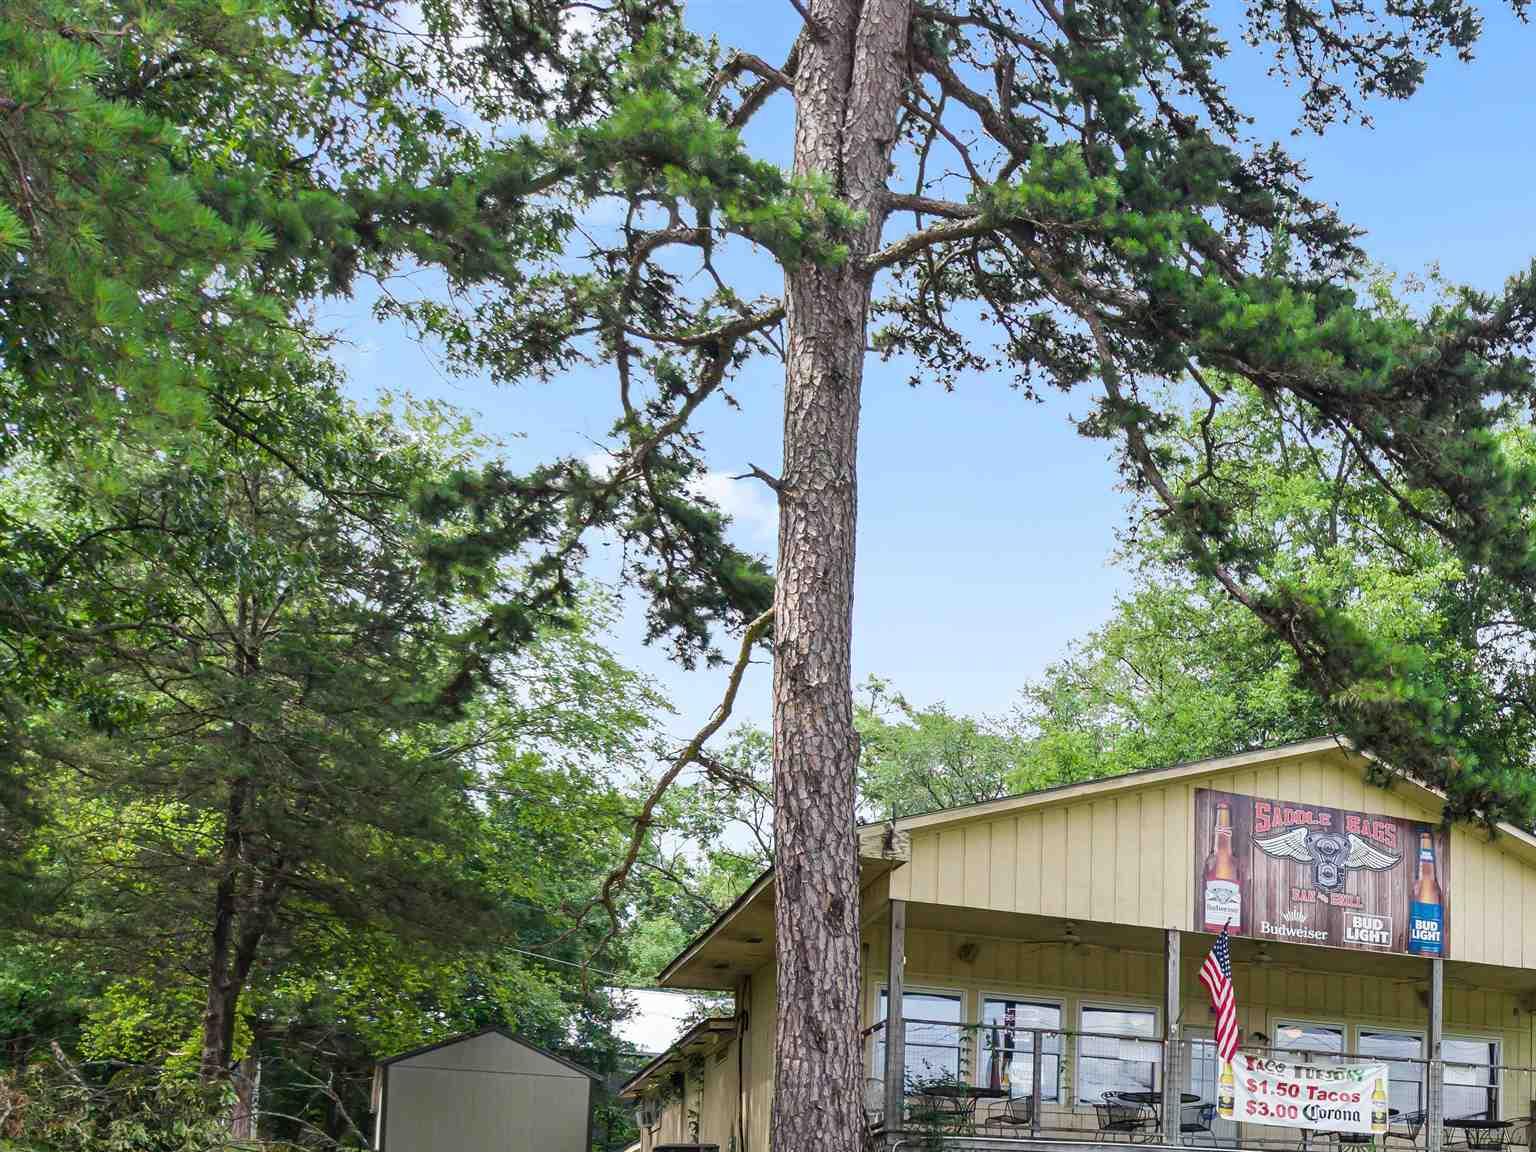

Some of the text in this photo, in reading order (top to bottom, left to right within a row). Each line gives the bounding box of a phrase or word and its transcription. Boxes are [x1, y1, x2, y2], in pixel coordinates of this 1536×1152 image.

[1346, 815, 1397, 848] BAGS
[1261, 921, 1328, 940] Budweiser
[1353, 916, 1383, 930] BUD
[1415, 920, 1438, 930] BUD
[1347, 928, 1389, 943] LIGHT
[1412, 929, 1441, 941] LIGHT
[1247, 1079, 1361, 1103] $1.50 Tacos
[1246, 1100, 1361, 1122] $3.00 Corona
